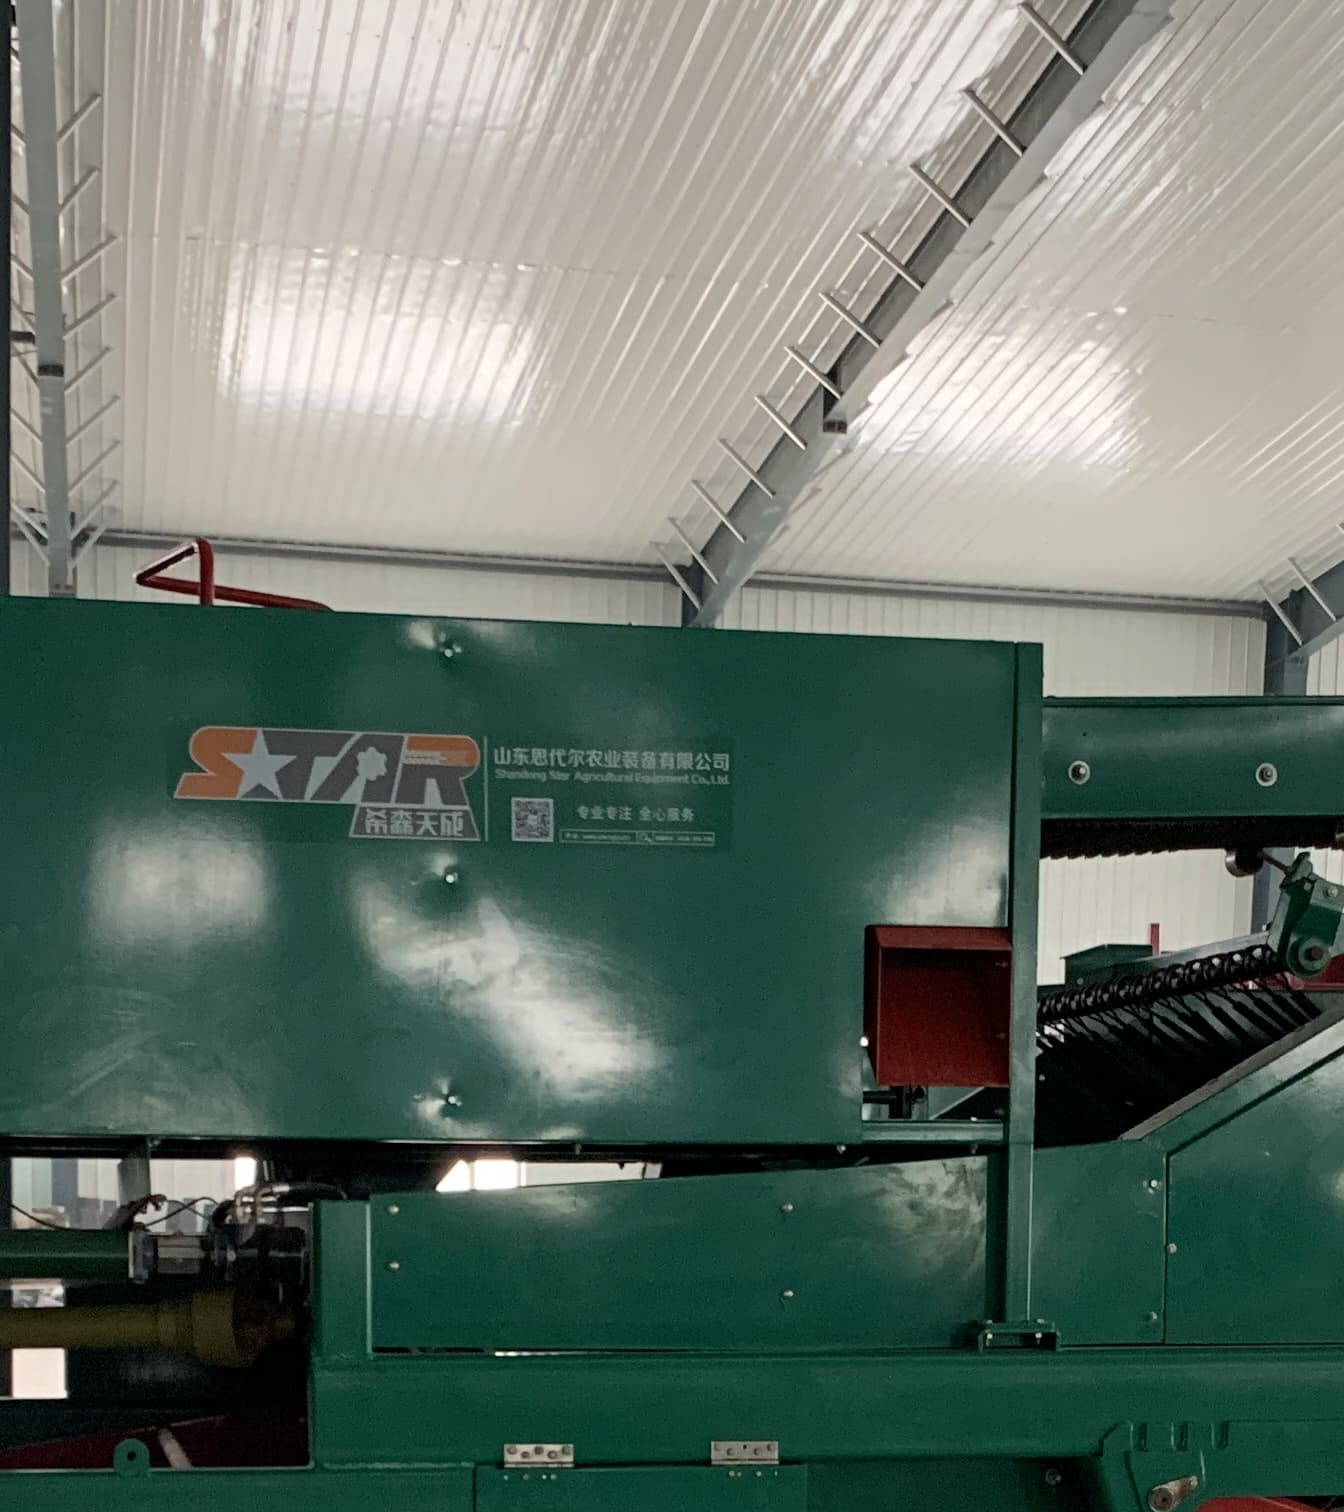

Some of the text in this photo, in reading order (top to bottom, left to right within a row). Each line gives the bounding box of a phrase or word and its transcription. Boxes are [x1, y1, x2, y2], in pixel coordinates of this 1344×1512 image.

[174, 726, 481, 807] STAR
[494, 747, 730, 771] 山东思代尔农业装备有限公司
